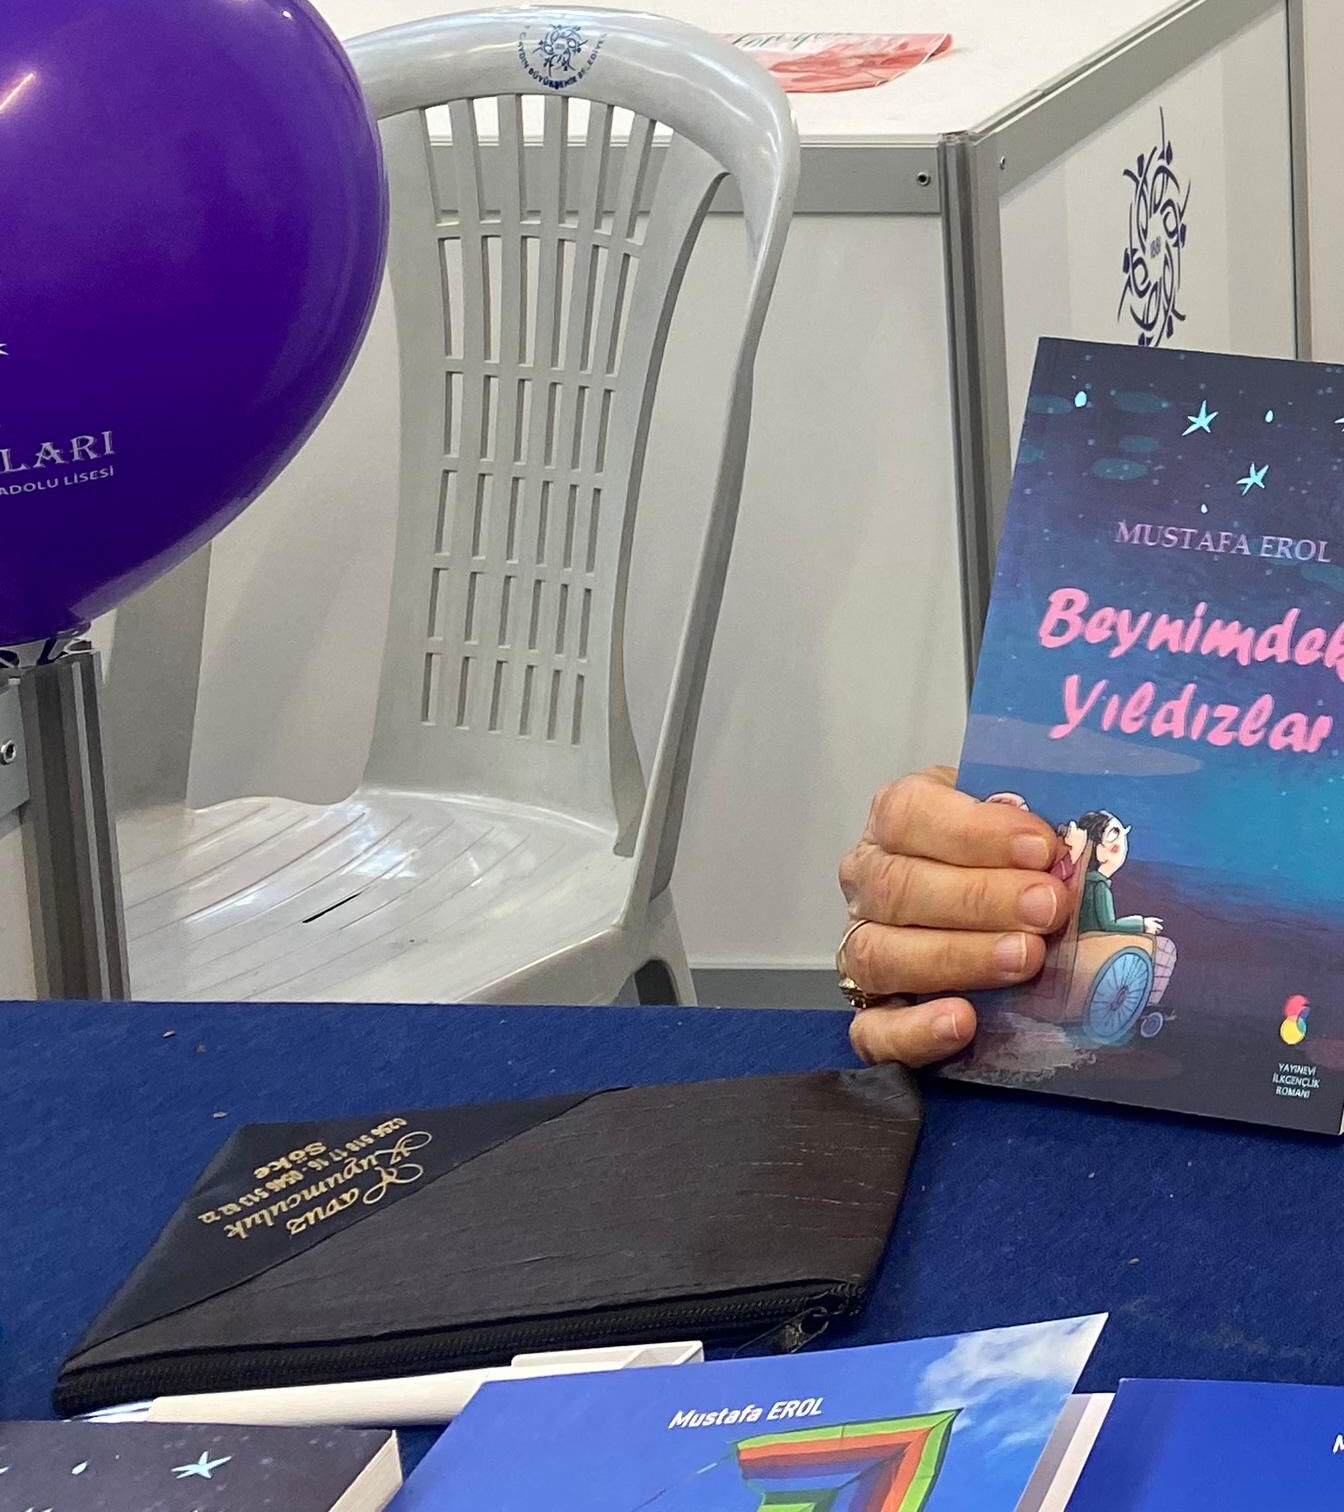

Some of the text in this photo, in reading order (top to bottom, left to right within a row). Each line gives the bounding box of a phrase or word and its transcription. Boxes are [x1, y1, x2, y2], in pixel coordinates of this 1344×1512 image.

[64, 465, 115, 485] LİSESİ
[1113, 520, 1332, 563] MUSTAFA EROL
[1049, 674, 1334, 753] Yıldızlar
[253, 1141, 327, 1180] Söke
[668, 1396, 823, 1430] Mustafa EROL
